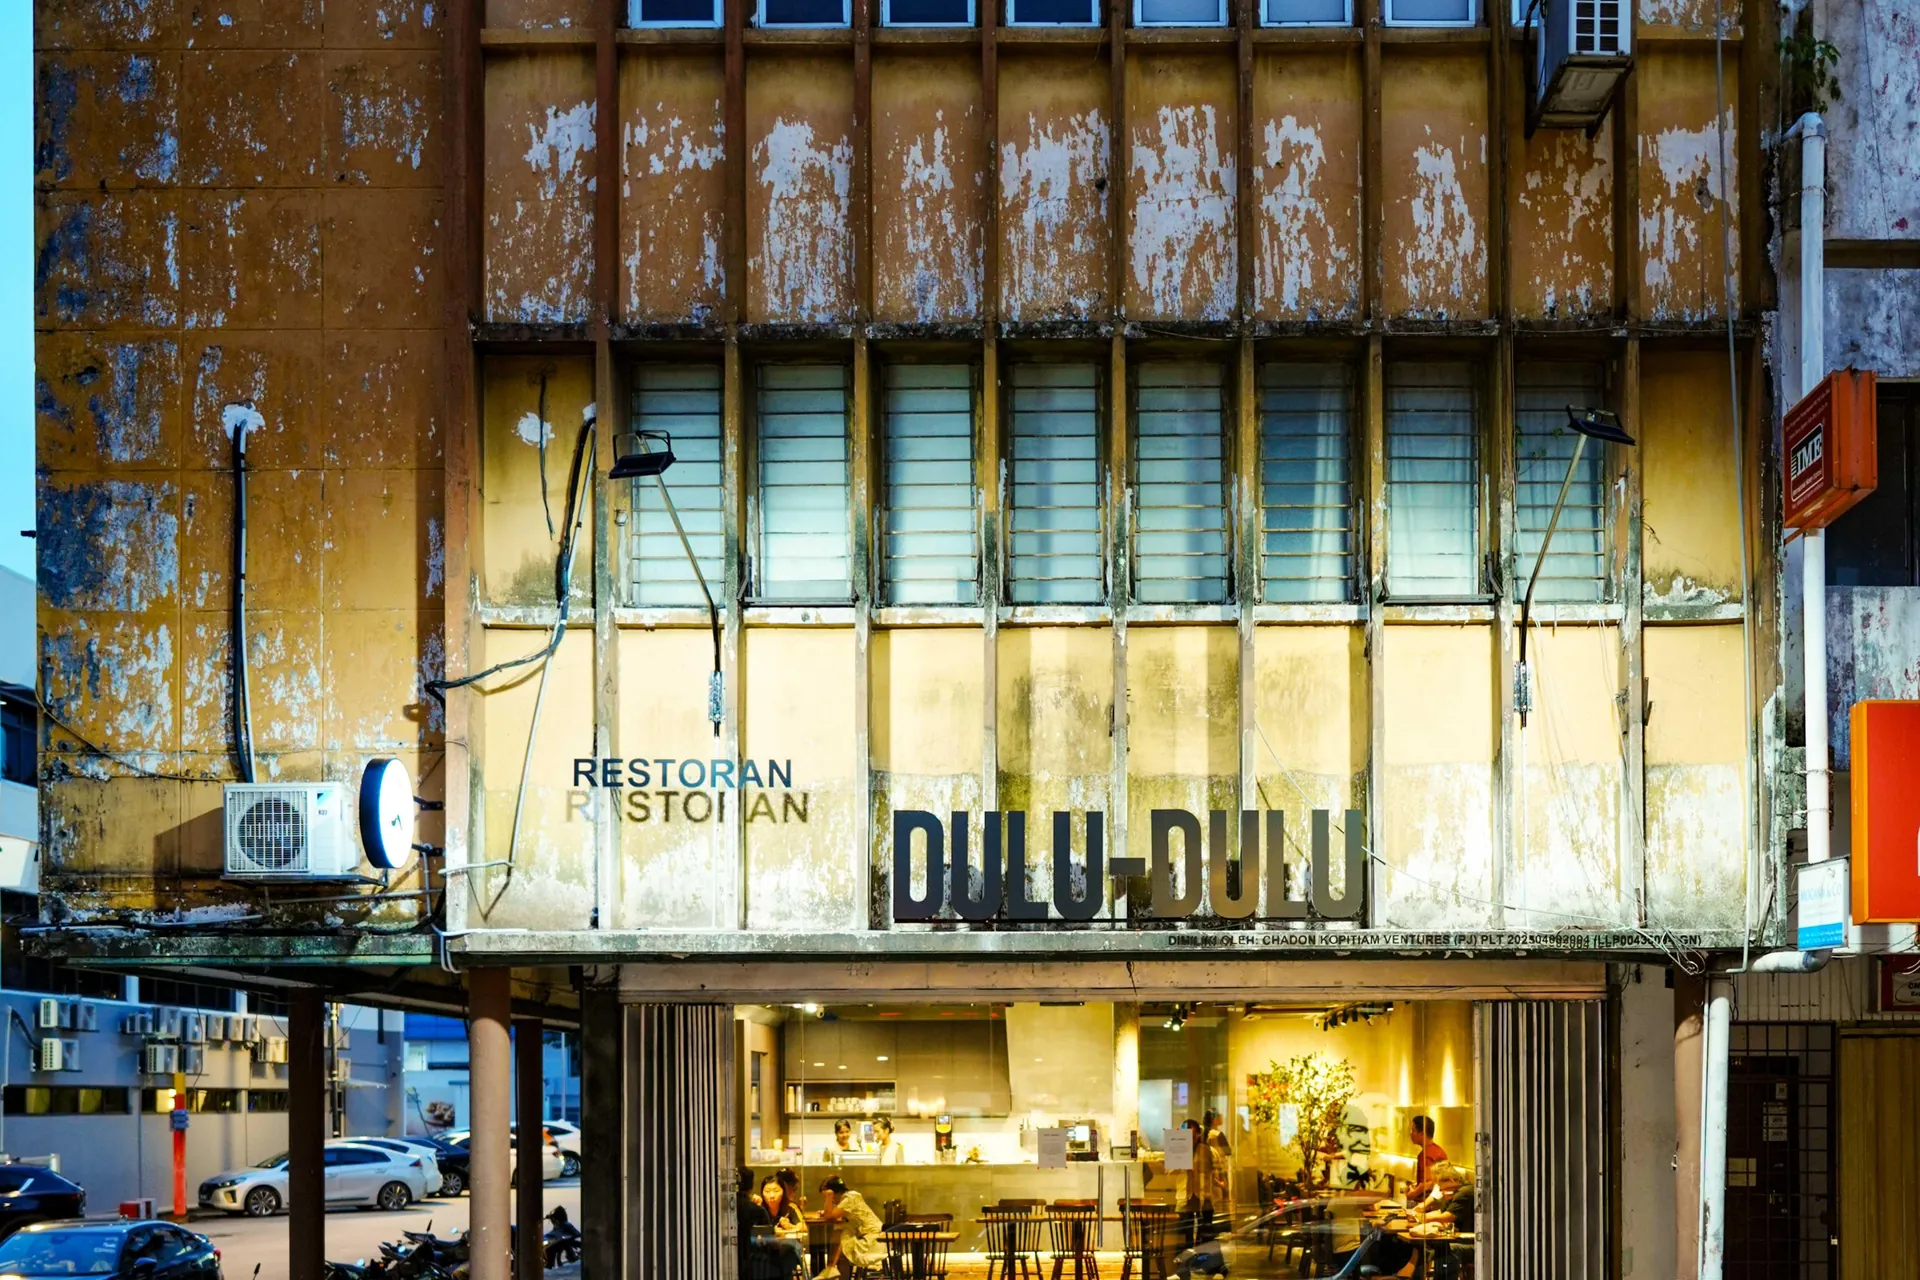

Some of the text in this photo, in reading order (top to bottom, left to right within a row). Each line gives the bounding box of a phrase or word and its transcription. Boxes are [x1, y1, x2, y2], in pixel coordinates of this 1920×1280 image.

[573, 758, 792, 788] RESTORAN
[893, 809, 1364, 919] DULU-DULU
[1220, 935, 1258, 946] OLEH:
[1262, 935, 1316, 945] CHADON
[1320, 935, 1380, 945] KOPITIAM
[1383, 934, 1450, 945] VENTURES
[1454, 934, 1477, 946] (PJ)
[1481, 934, 1504, 945] PLT
